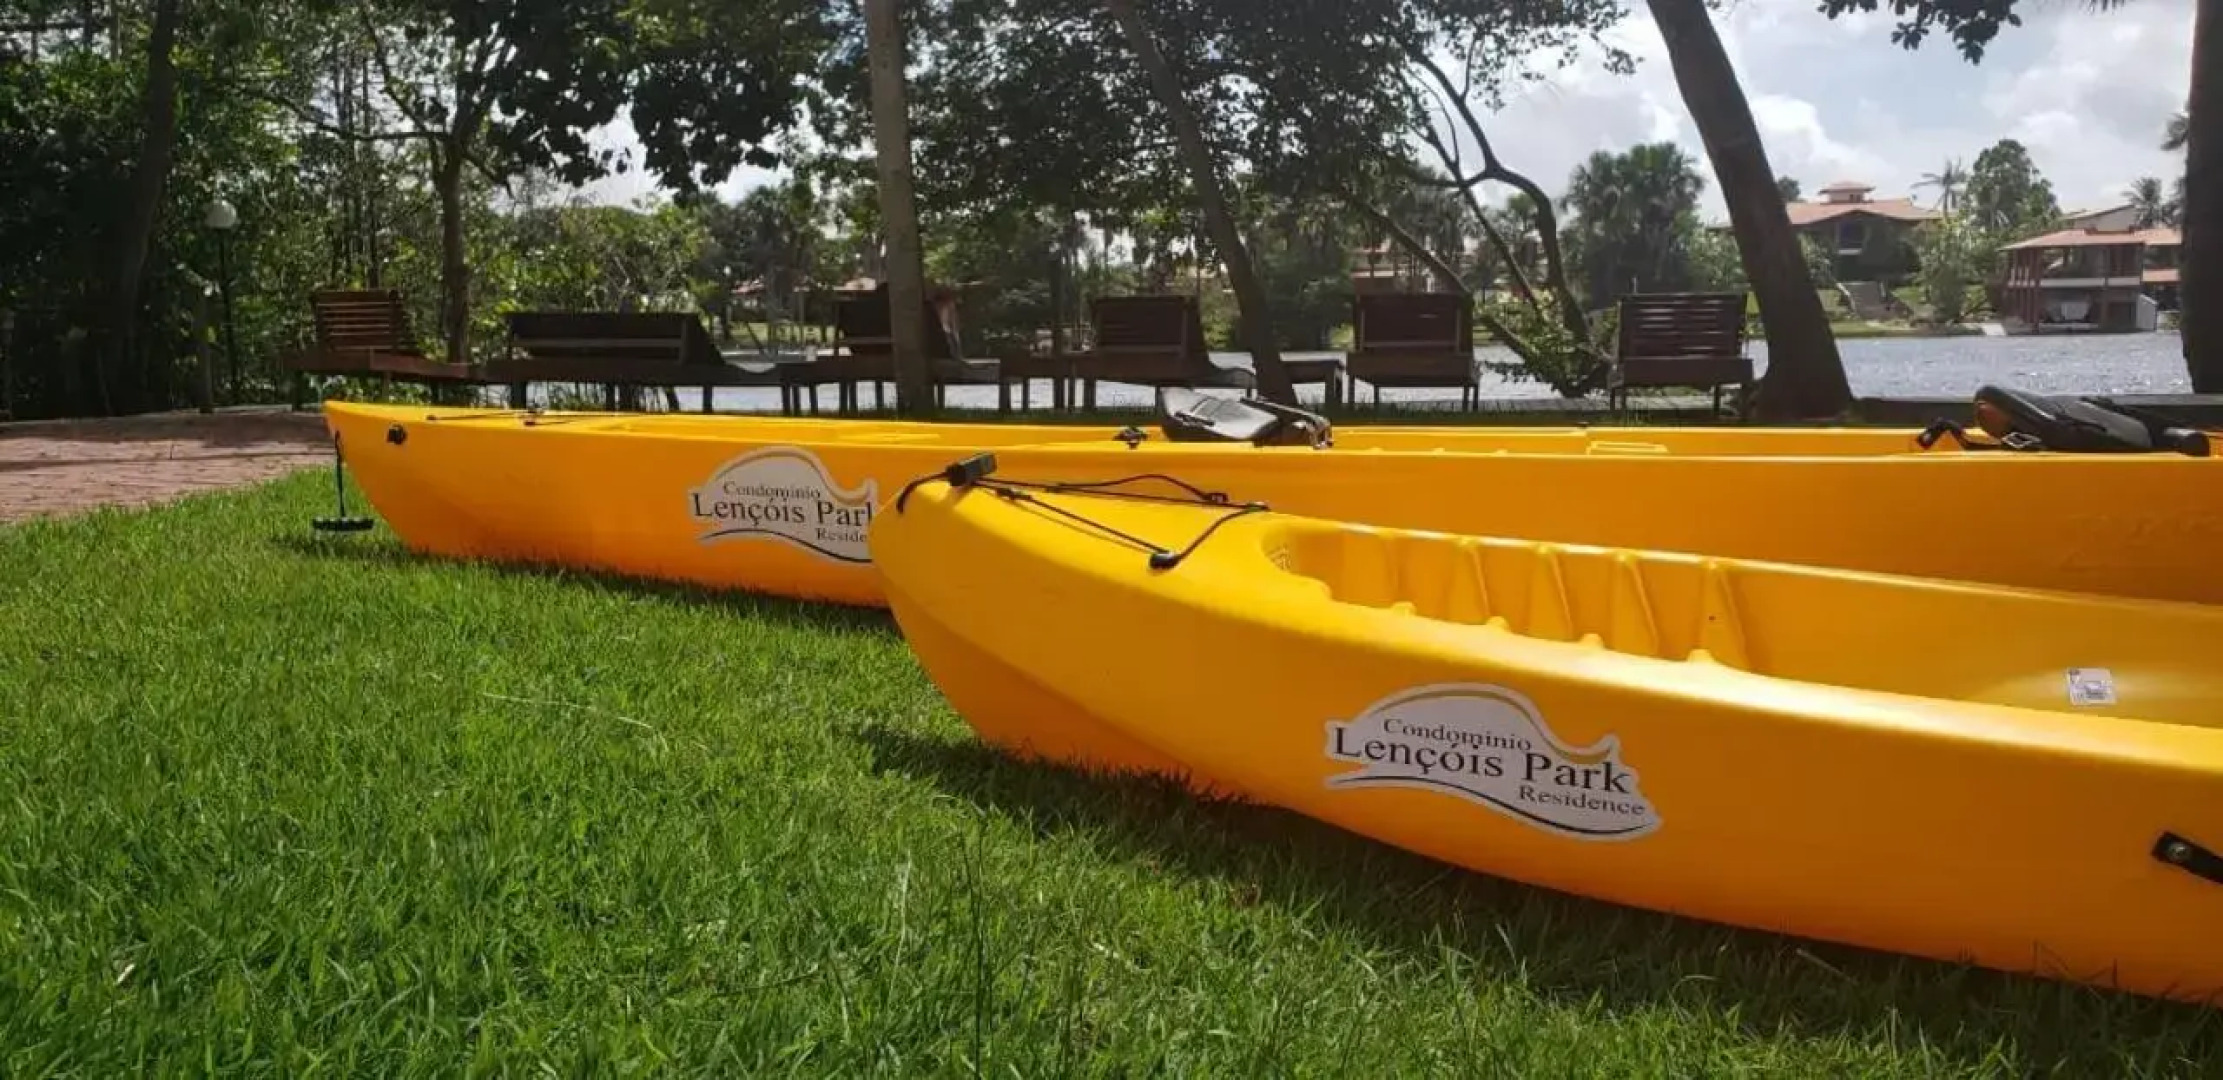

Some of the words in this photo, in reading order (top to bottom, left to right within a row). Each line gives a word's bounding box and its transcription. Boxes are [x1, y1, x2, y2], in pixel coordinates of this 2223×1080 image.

[693, 493, 805, 525] Lençóis
[815, 527, 867, 543] Reside
[1335, 727, 1504, 776] Lençóis
[1522, 751, 1630, 795] Park
[1519, 784, 1646, 815] Residence
